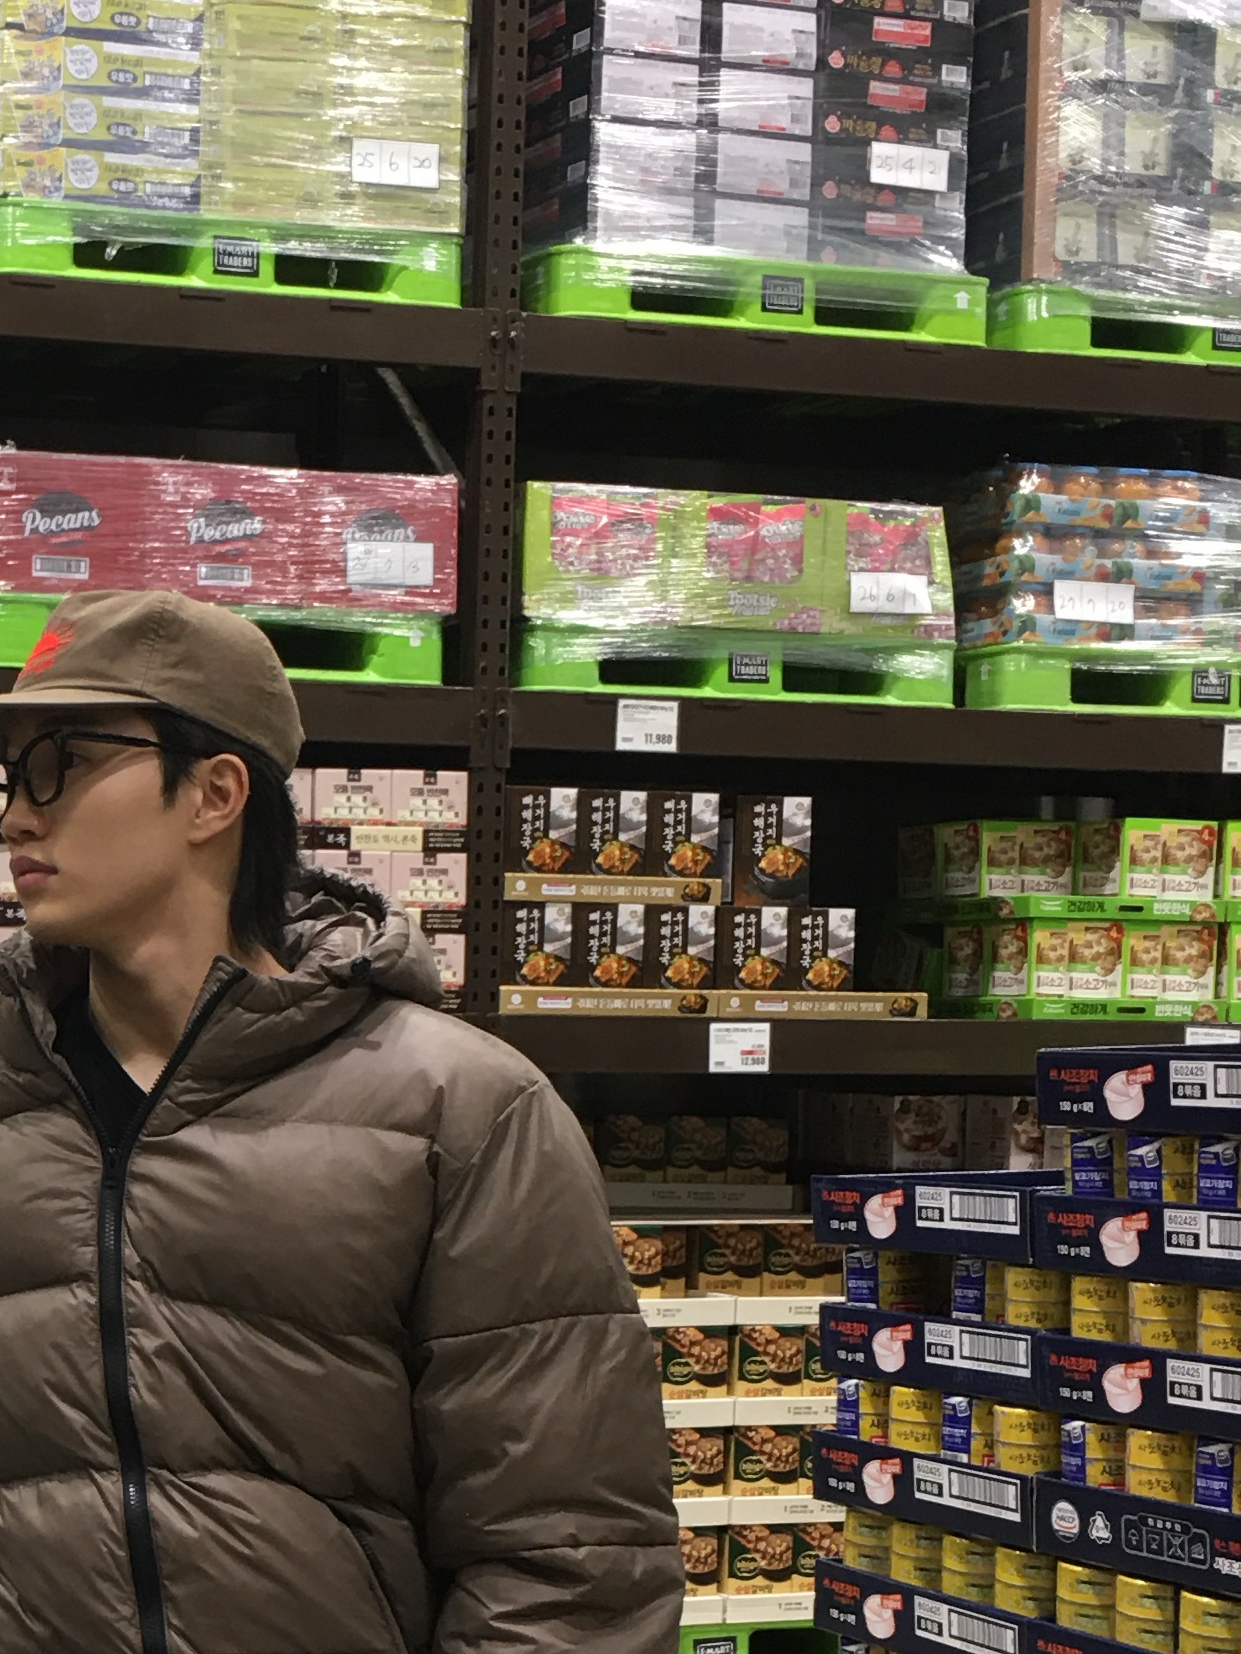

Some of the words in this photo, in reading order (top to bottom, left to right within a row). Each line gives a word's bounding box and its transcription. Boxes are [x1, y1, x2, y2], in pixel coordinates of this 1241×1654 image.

[355, 151, 375, 168] 25
[388, 152, 399, 173] 6
[875, 154, 894, 172] 25
[902, 157, 916, 174] 4
[21, 506, 103, 538] Pecans
[186, 515, 264, 546] Pecans
[643, 732, 674, 745] 11,980
[1173, 1064, 1206, 1077] 602425
[1167, 1212, 1198, 1227] 602425
[1170, 1363, 1201, 1379] 602425
